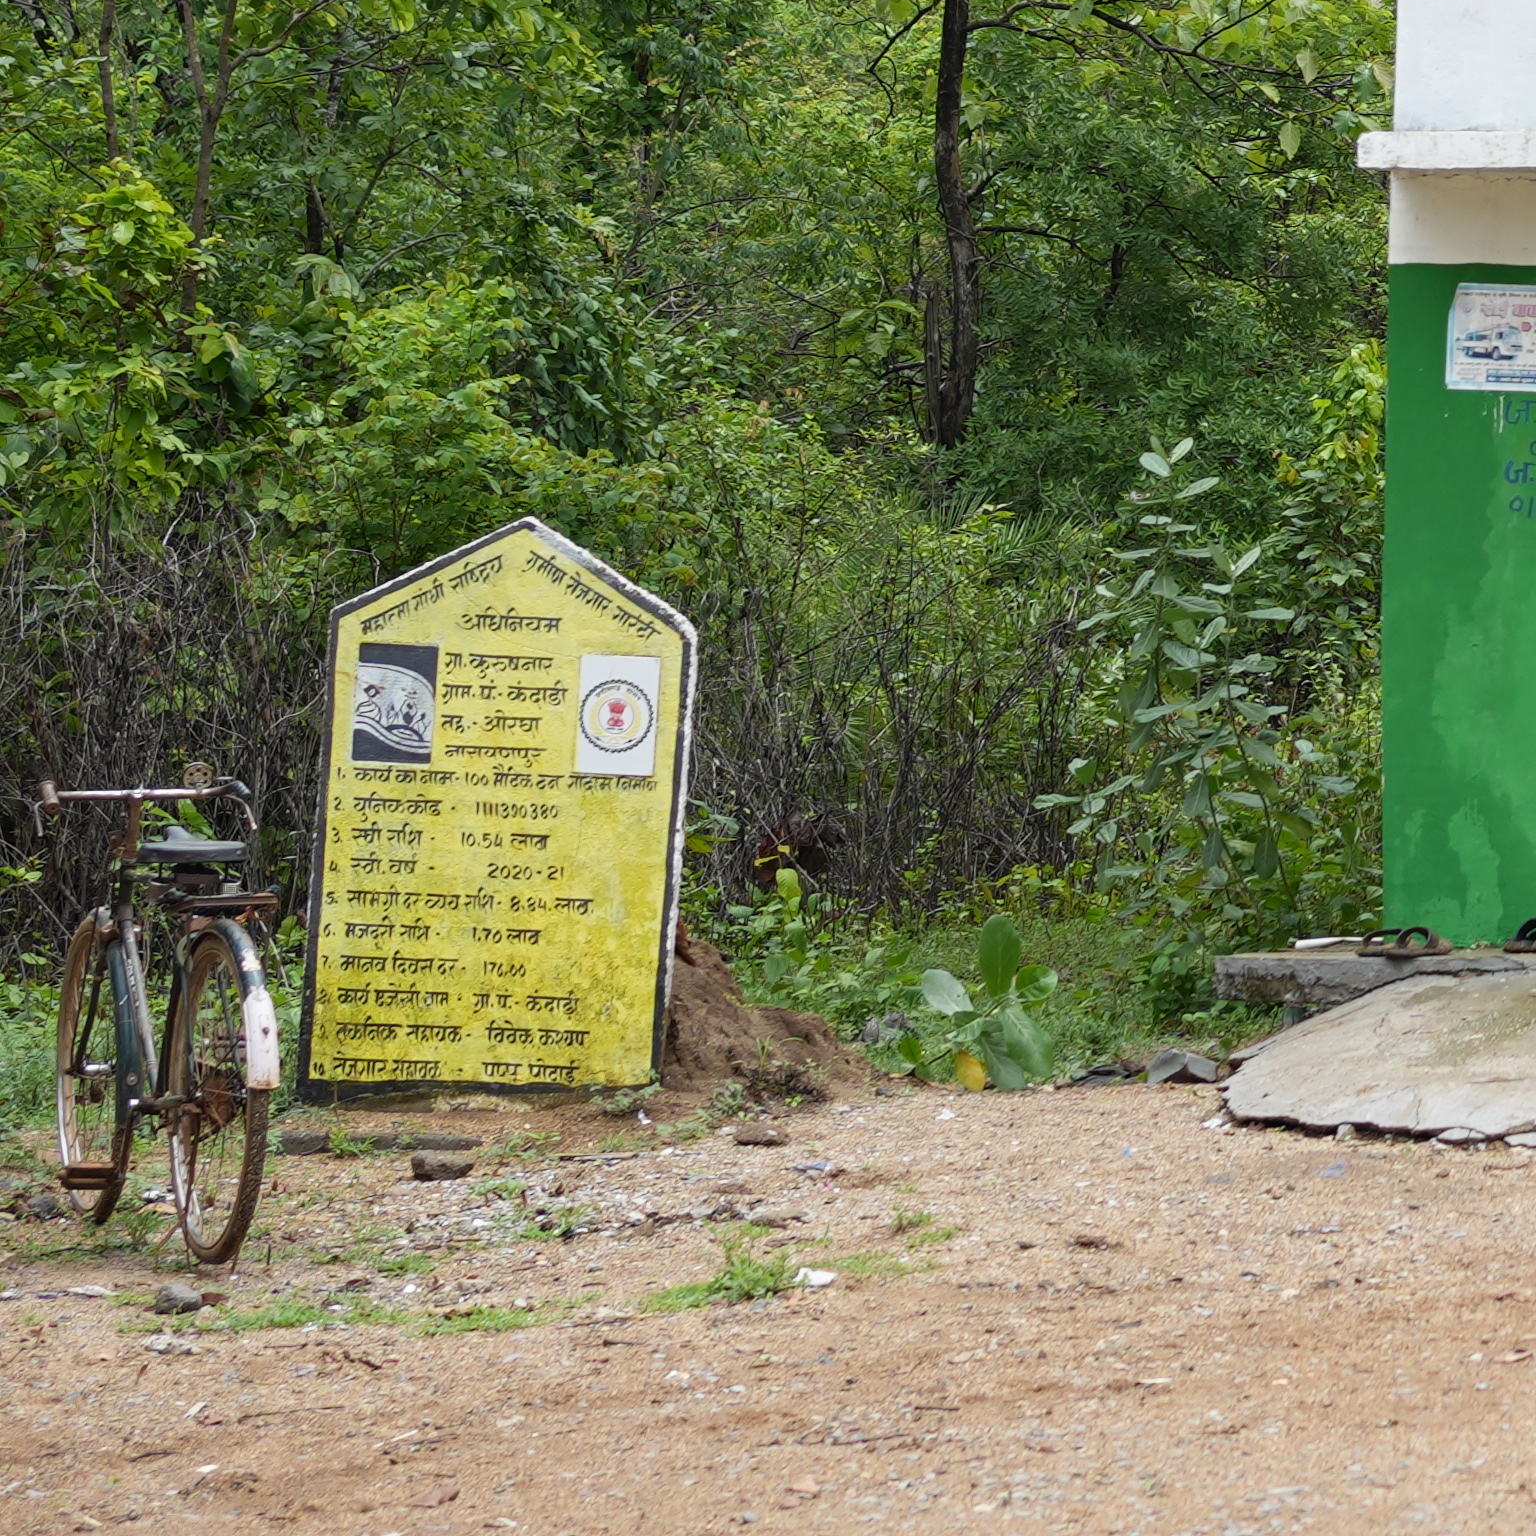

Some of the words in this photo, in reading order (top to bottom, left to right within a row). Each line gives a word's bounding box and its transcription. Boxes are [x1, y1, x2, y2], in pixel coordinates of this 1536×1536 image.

[456, 606, 562, 634] अधिनियम
[445, 744, 547, 769] नारायणपुर
[395, 769, 417, 784] का
[465, 772, 490, 787] 100
